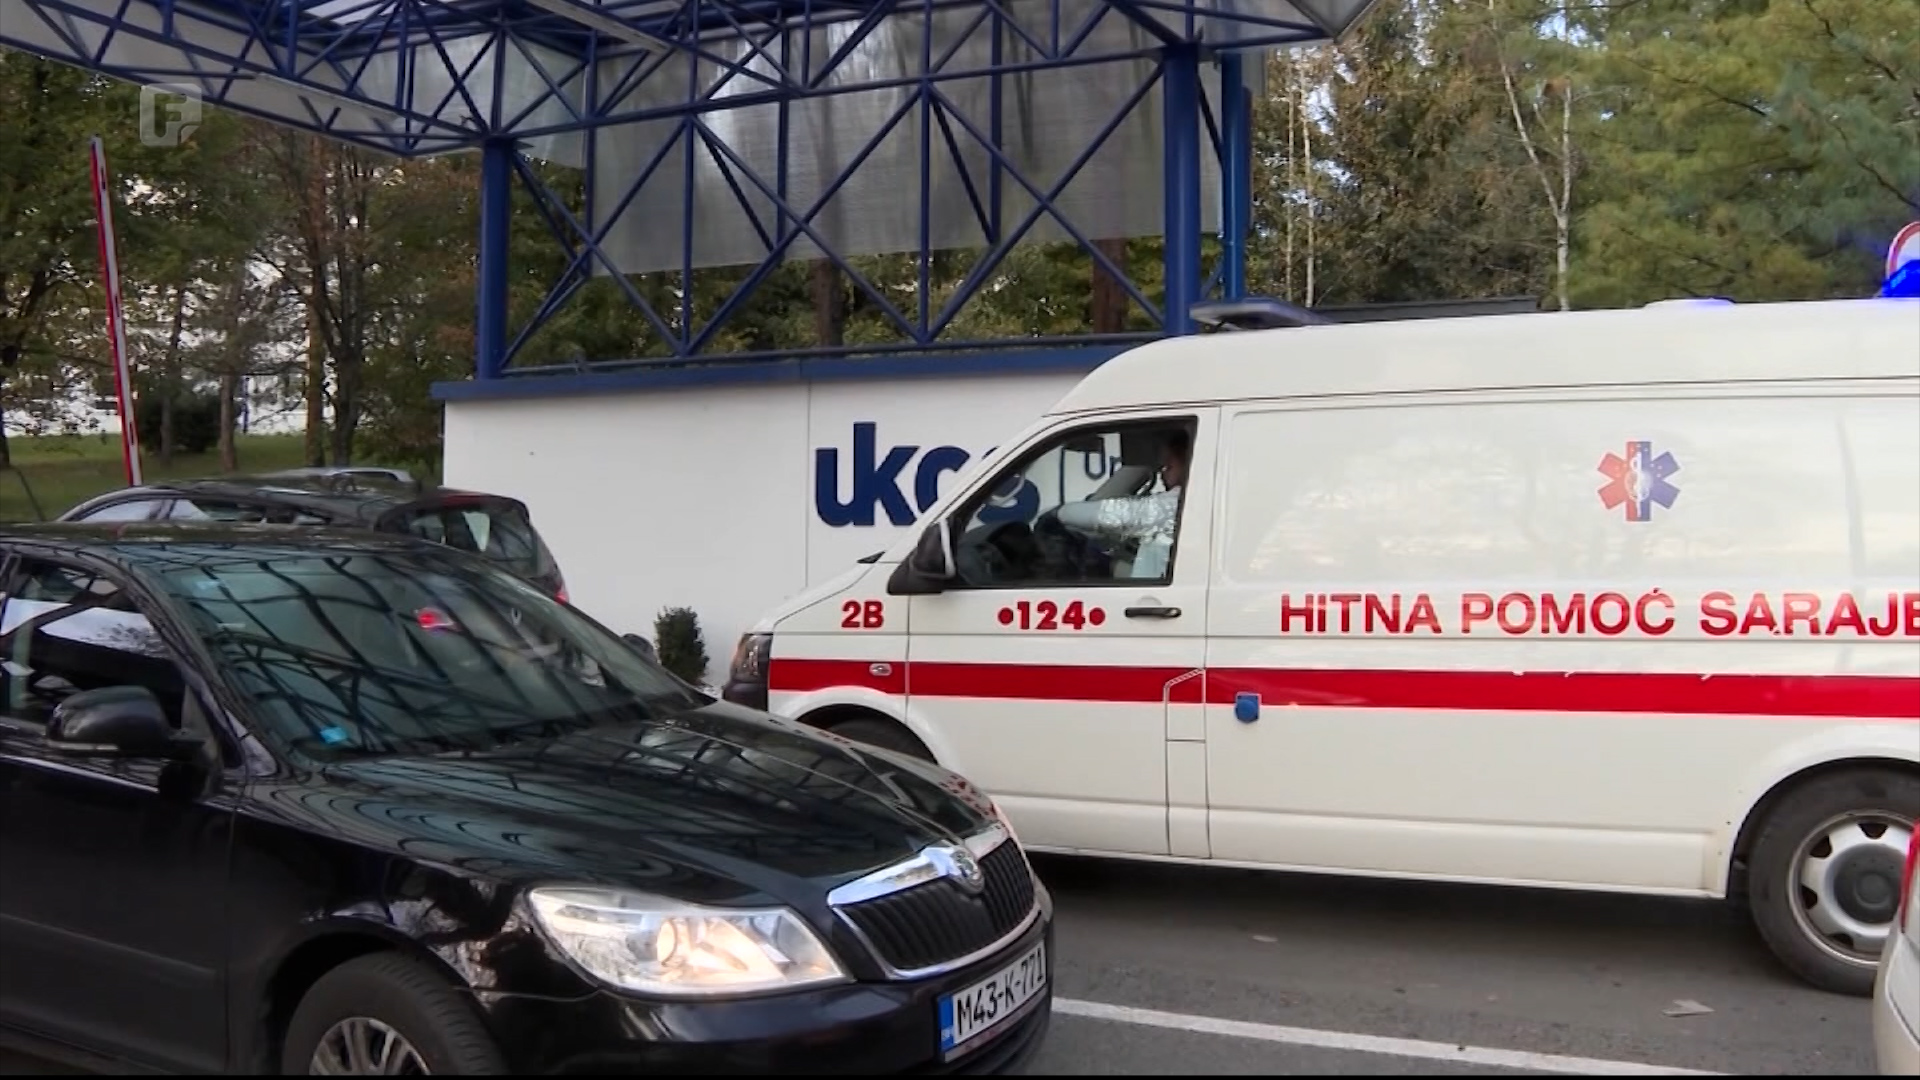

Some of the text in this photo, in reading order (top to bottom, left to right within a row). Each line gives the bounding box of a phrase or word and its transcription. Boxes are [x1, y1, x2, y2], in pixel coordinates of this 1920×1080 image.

[841, 600, 884, 630] 2B
[1460, 587, 1676, 637] POMOĆ
[1699, 592, 1920, 636] SARAJE
[957, 947, 1043, 1036] M43-K-771
